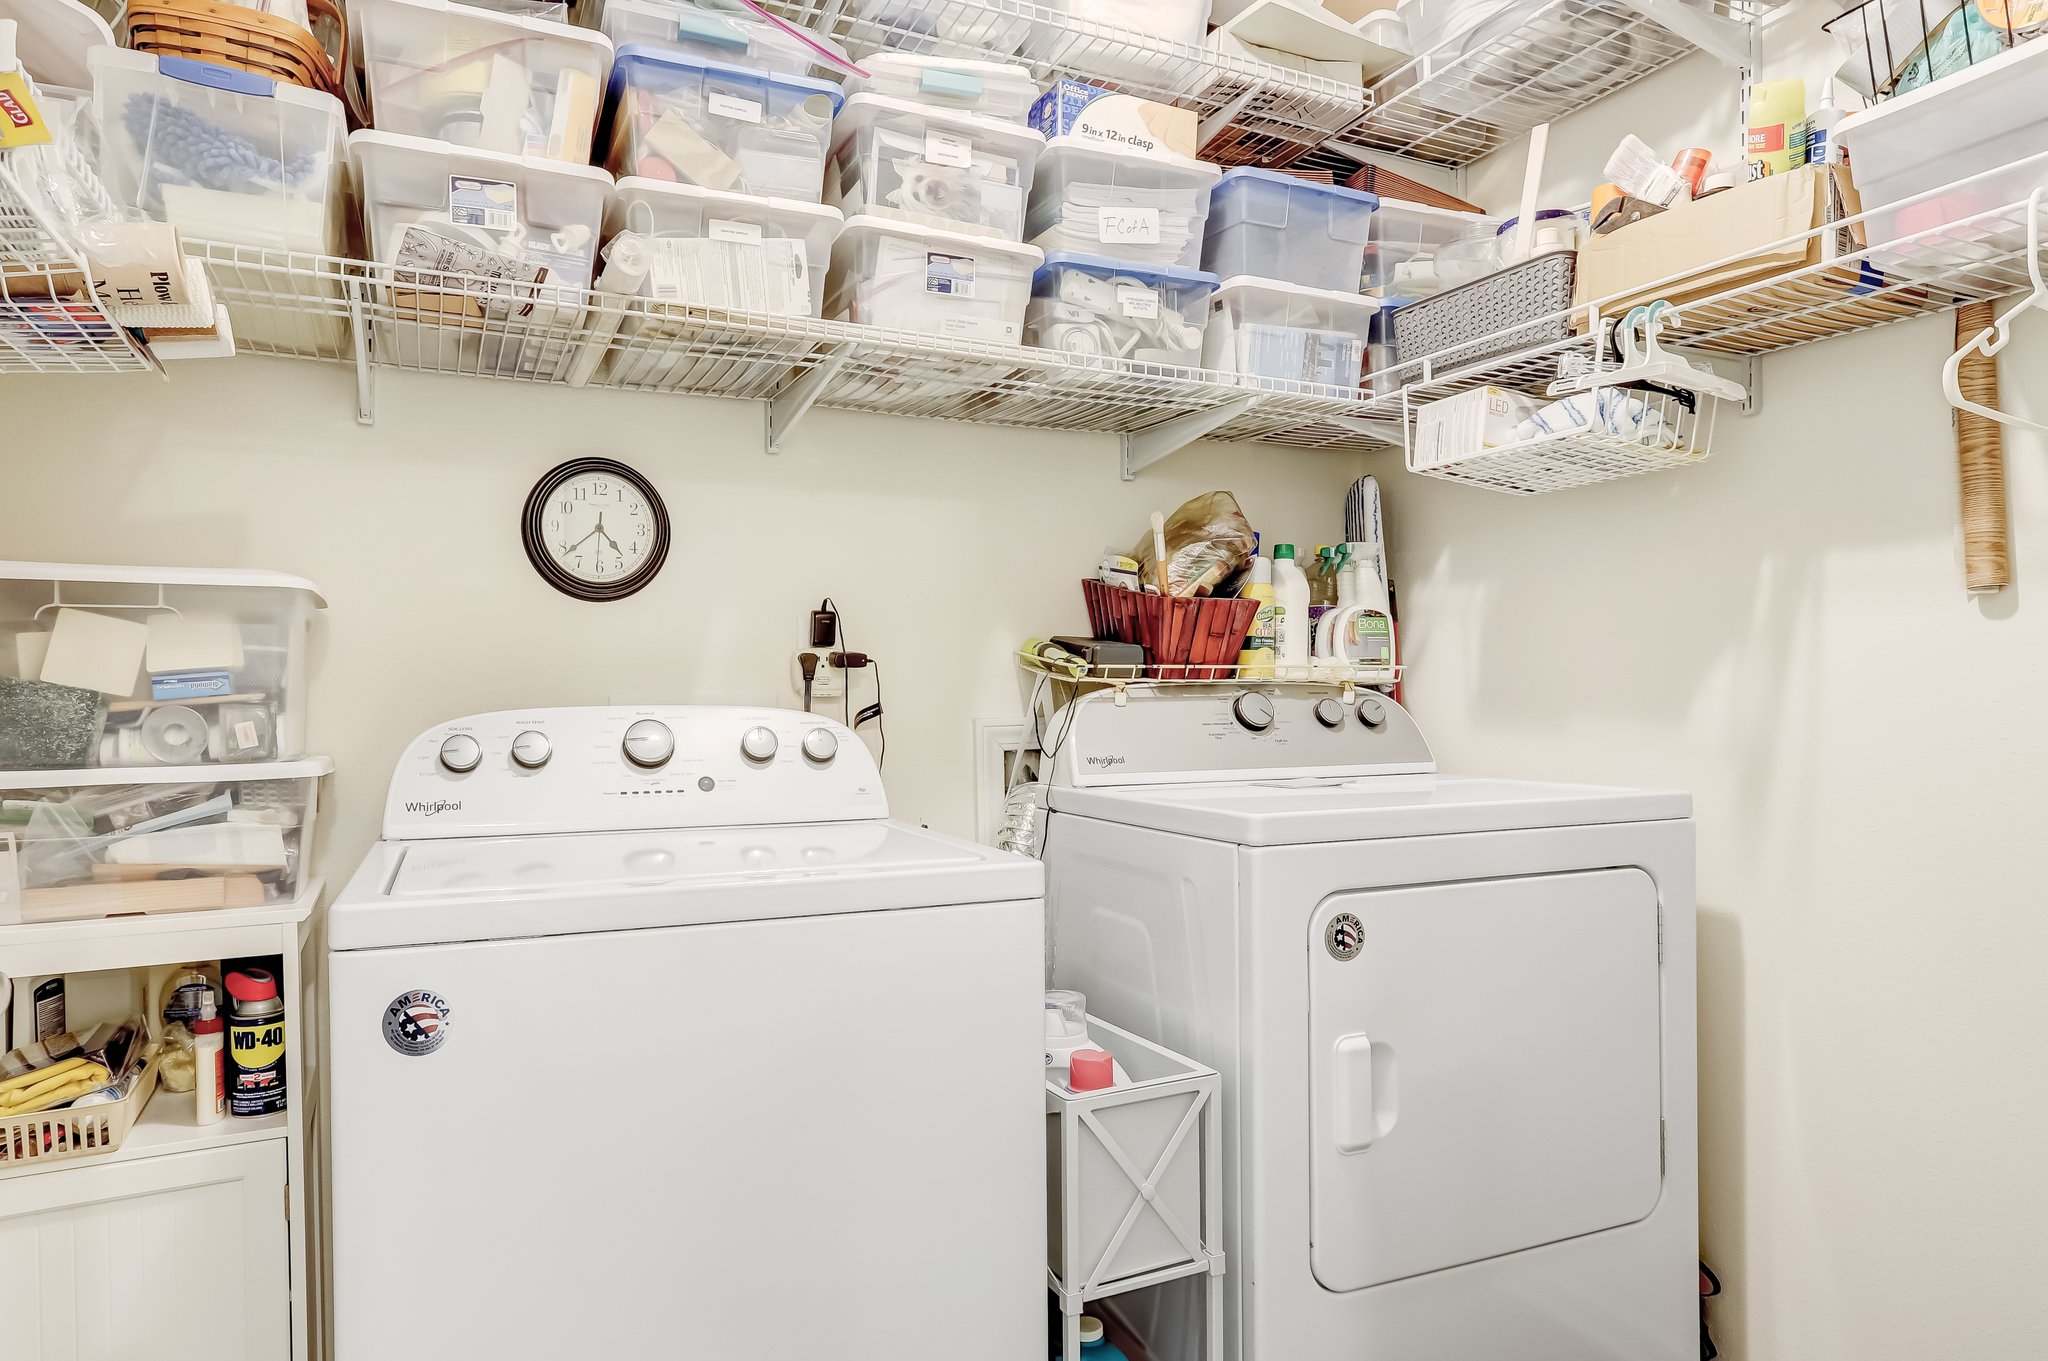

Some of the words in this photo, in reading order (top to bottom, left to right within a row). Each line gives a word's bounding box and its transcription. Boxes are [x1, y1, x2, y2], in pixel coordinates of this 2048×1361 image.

[1063, 83, 1089, 95] Office
[1066, 91, 1089, 101] DEPOT
[0, 91, 29, 125] GLAD
[1128, 135, 1154, 152] clasp
[1748, 134, 1766, 144] ORE
[1489, 397, 1509, 414] LED
[573, 487, 587, 501] 11
[592, 482, 608, 496] 12
[617, 489, 623, 503] 1
[559, 500, 573, 515] 10
[629, 502, 638, 516] 2
[551, 519, 560, 533] 9
[637, 523, 646, 537] 3
[558, 540, 568, 553] 8
[629, 541, 638, 554] 4
[574, 555, 583, 569] 7
[595, 560, 604, 574] 6
[614, 556, 624, 570] 5
[1358, 618, 1385, 629] Bona
[1255, 628, 1272, 636] CITR
[189, 680, 219, 691] diamond
[1085, 754, 1126, 769] Whirlpool
[405, 800, 462, 816] Whirlpool
[1336, 914, 1364, 944] AMERICA
[389, 992, 451, 1018] AMERICA
[233, 1026, 283, 1050] WD-40
[253, 1073, 260, 1081] 2
